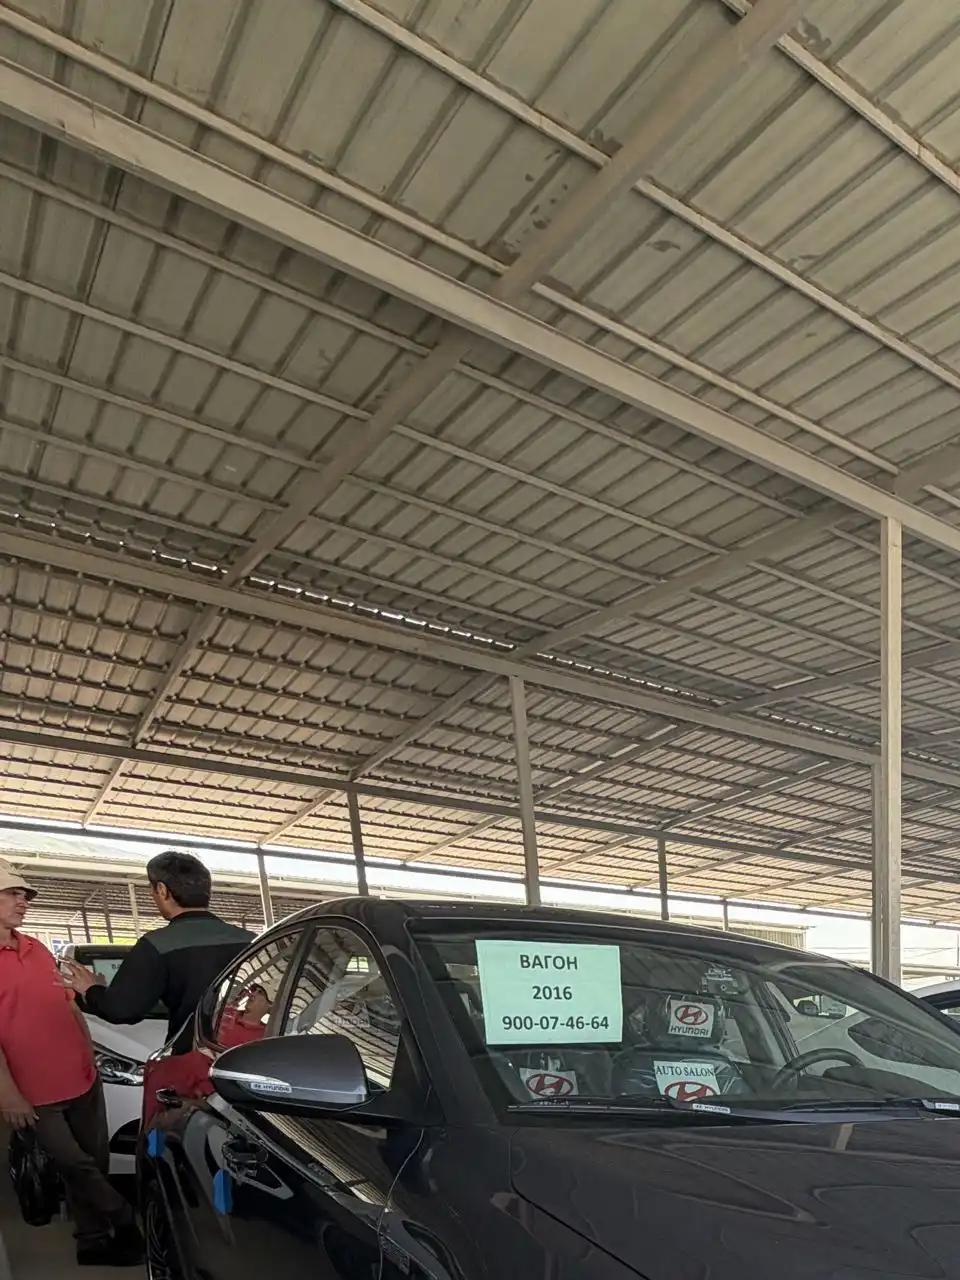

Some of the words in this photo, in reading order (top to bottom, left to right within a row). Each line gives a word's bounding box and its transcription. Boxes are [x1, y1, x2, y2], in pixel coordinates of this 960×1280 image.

[519, 954, 578, 970] ВАГОН
[532, 985, 573, 1001] 2016
[502, 1015, 609, 1031] 900-07-46-64
[670, 1024, 709, 1036] HYUNDAI
[655, 1065, 682, 1076] AUTO
[683, 1067, 716, 1077] SALON
